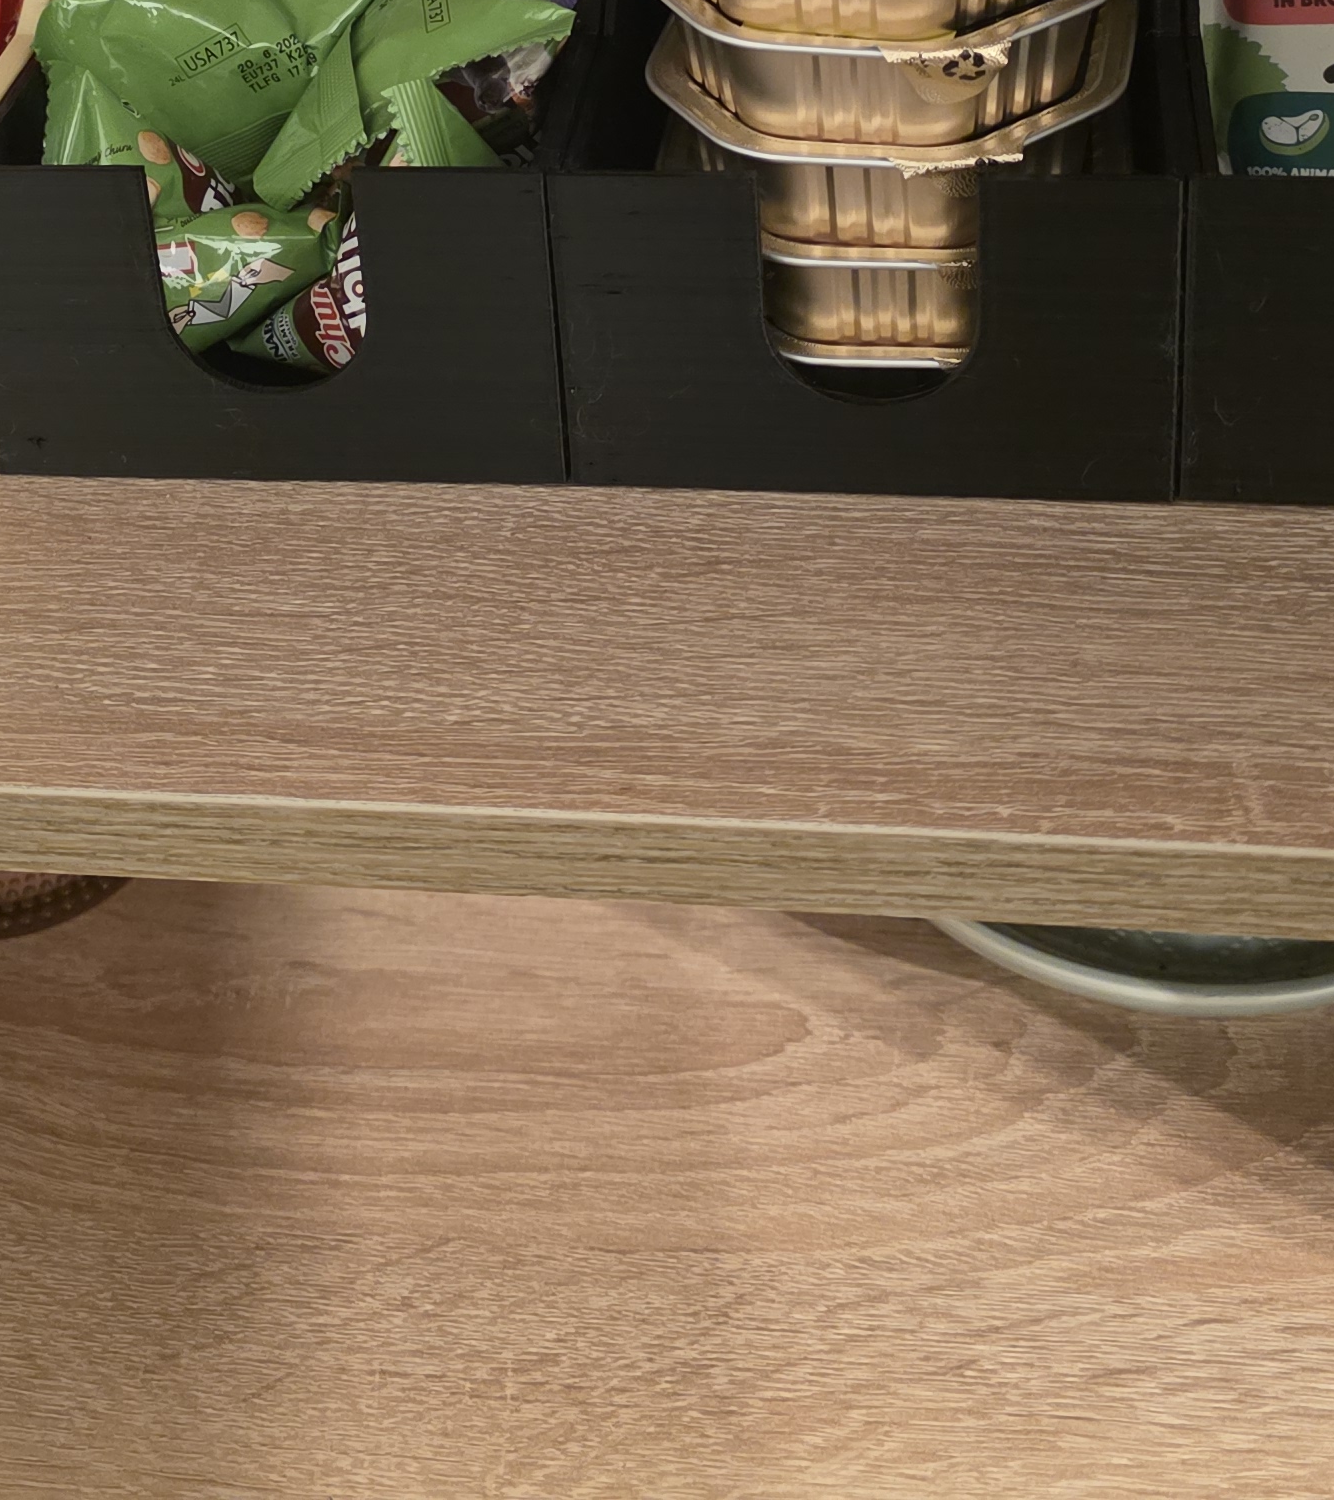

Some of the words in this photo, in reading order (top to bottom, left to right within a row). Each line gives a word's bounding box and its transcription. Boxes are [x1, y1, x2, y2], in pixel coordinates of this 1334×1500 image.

[241, 58, 280, 85] EU737
[247, 72, 282, 94] TLFG
[310, 278, 356, 369] Chur
